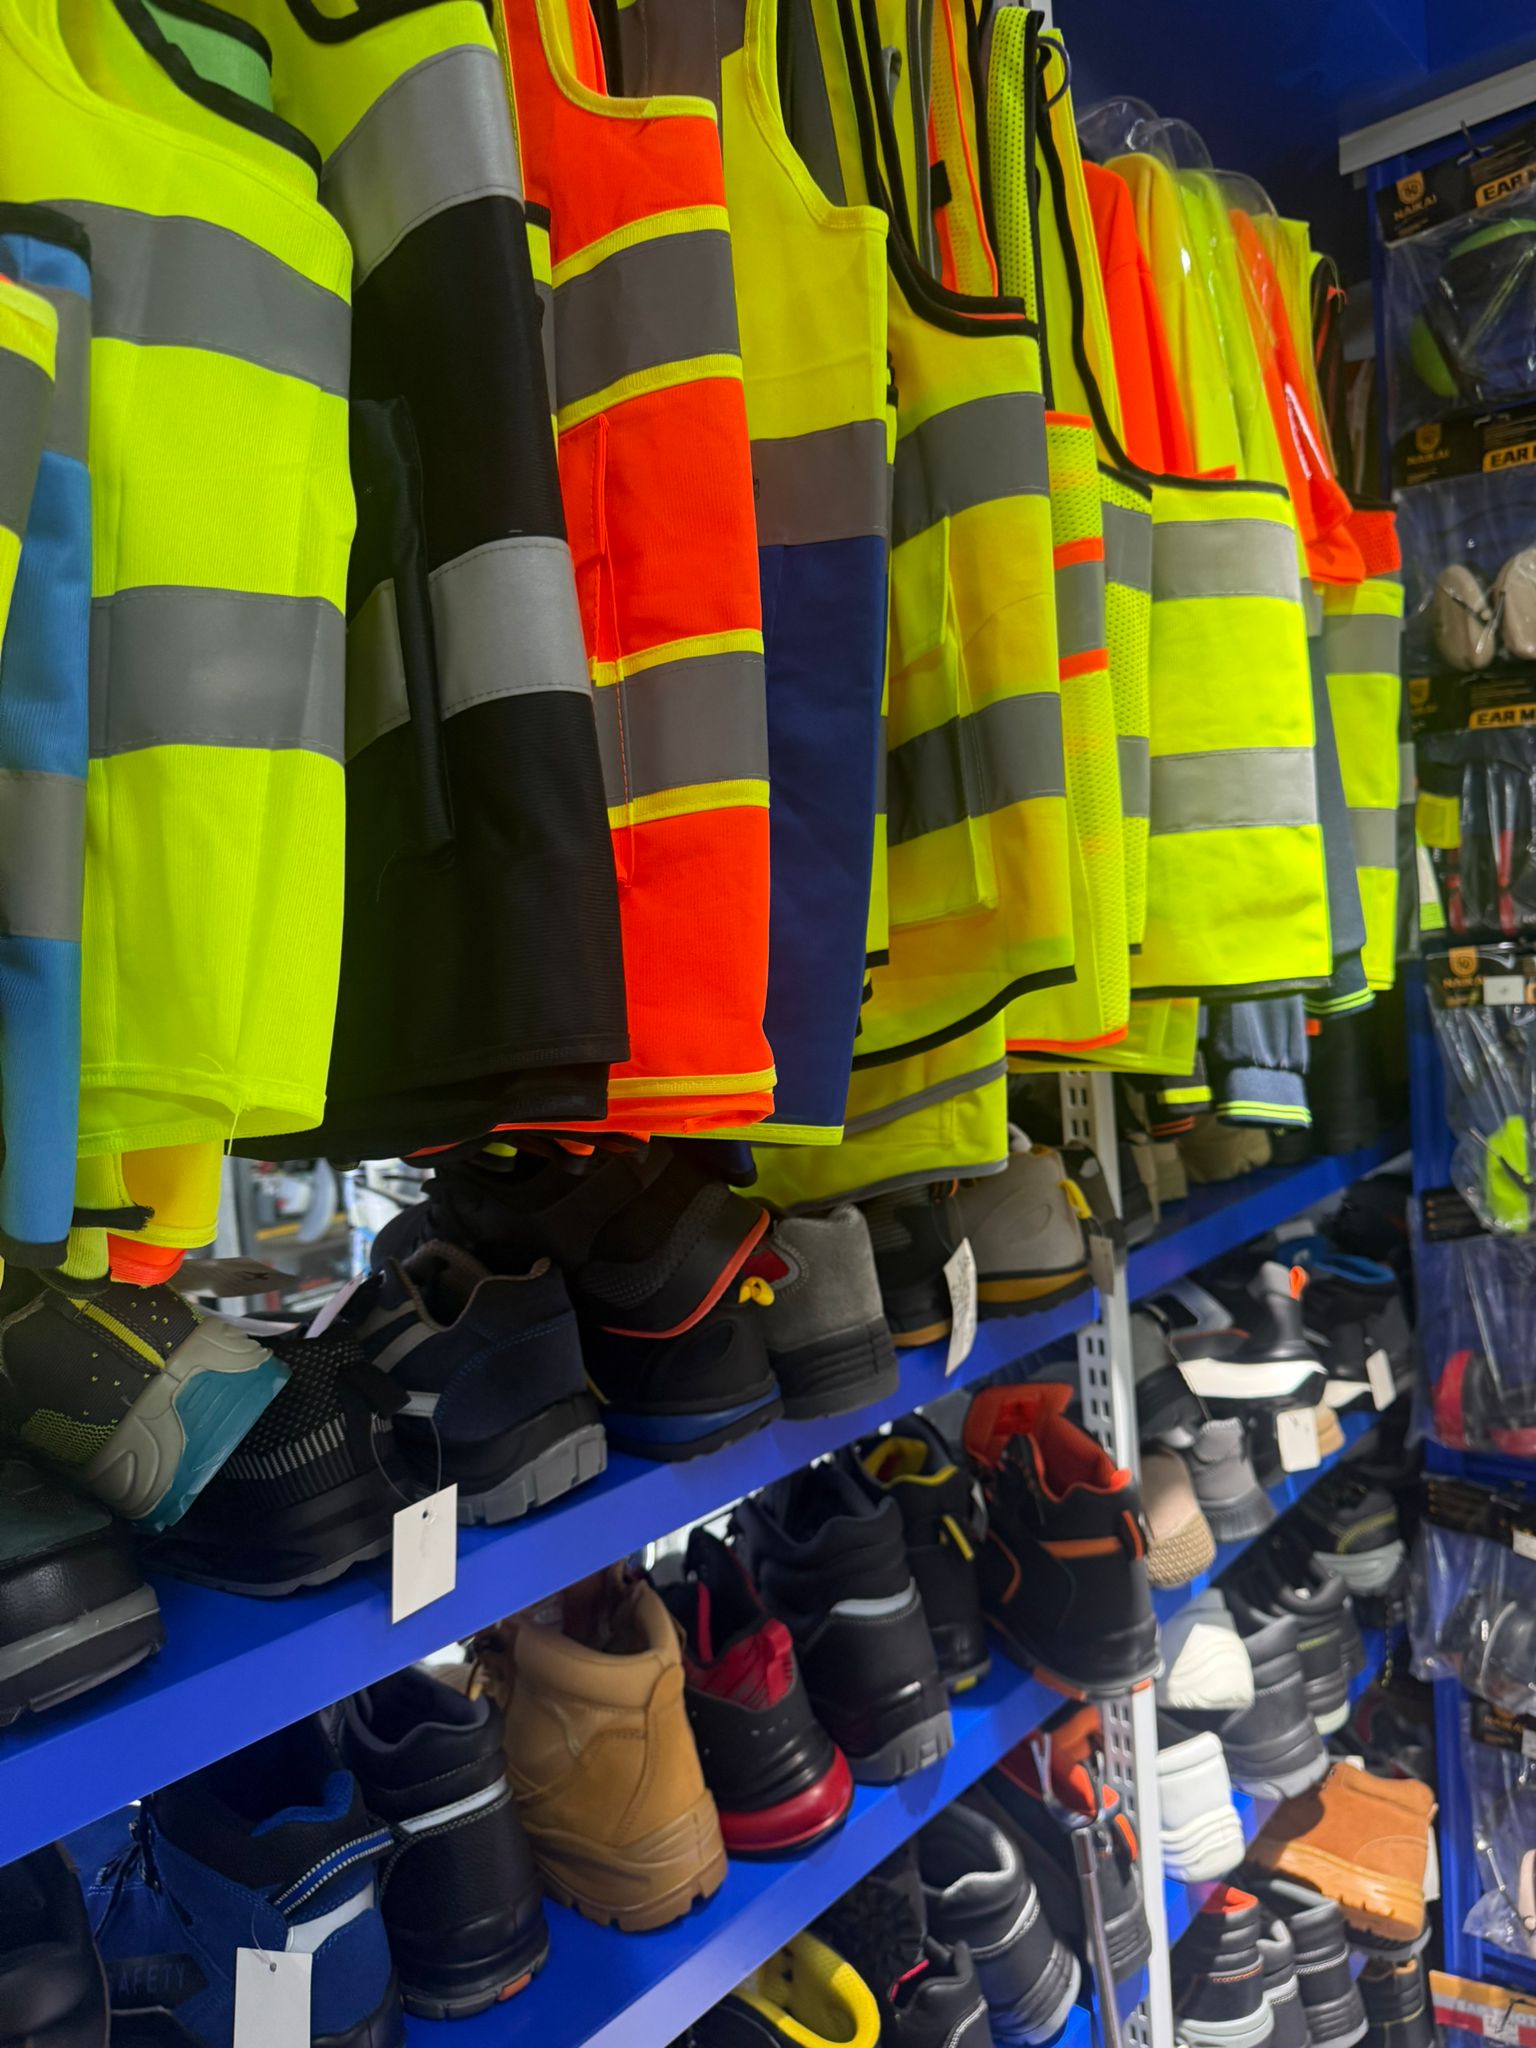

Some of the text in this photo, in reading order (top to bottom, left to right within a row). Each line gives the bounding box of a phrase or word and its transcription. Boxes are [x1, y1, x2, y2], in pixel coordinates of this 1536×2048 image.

[1483, 172, 1525, 201] EAR
[1490, 447, 1528, 469] EAR
[1477, 711, 1516, 726] EAR
